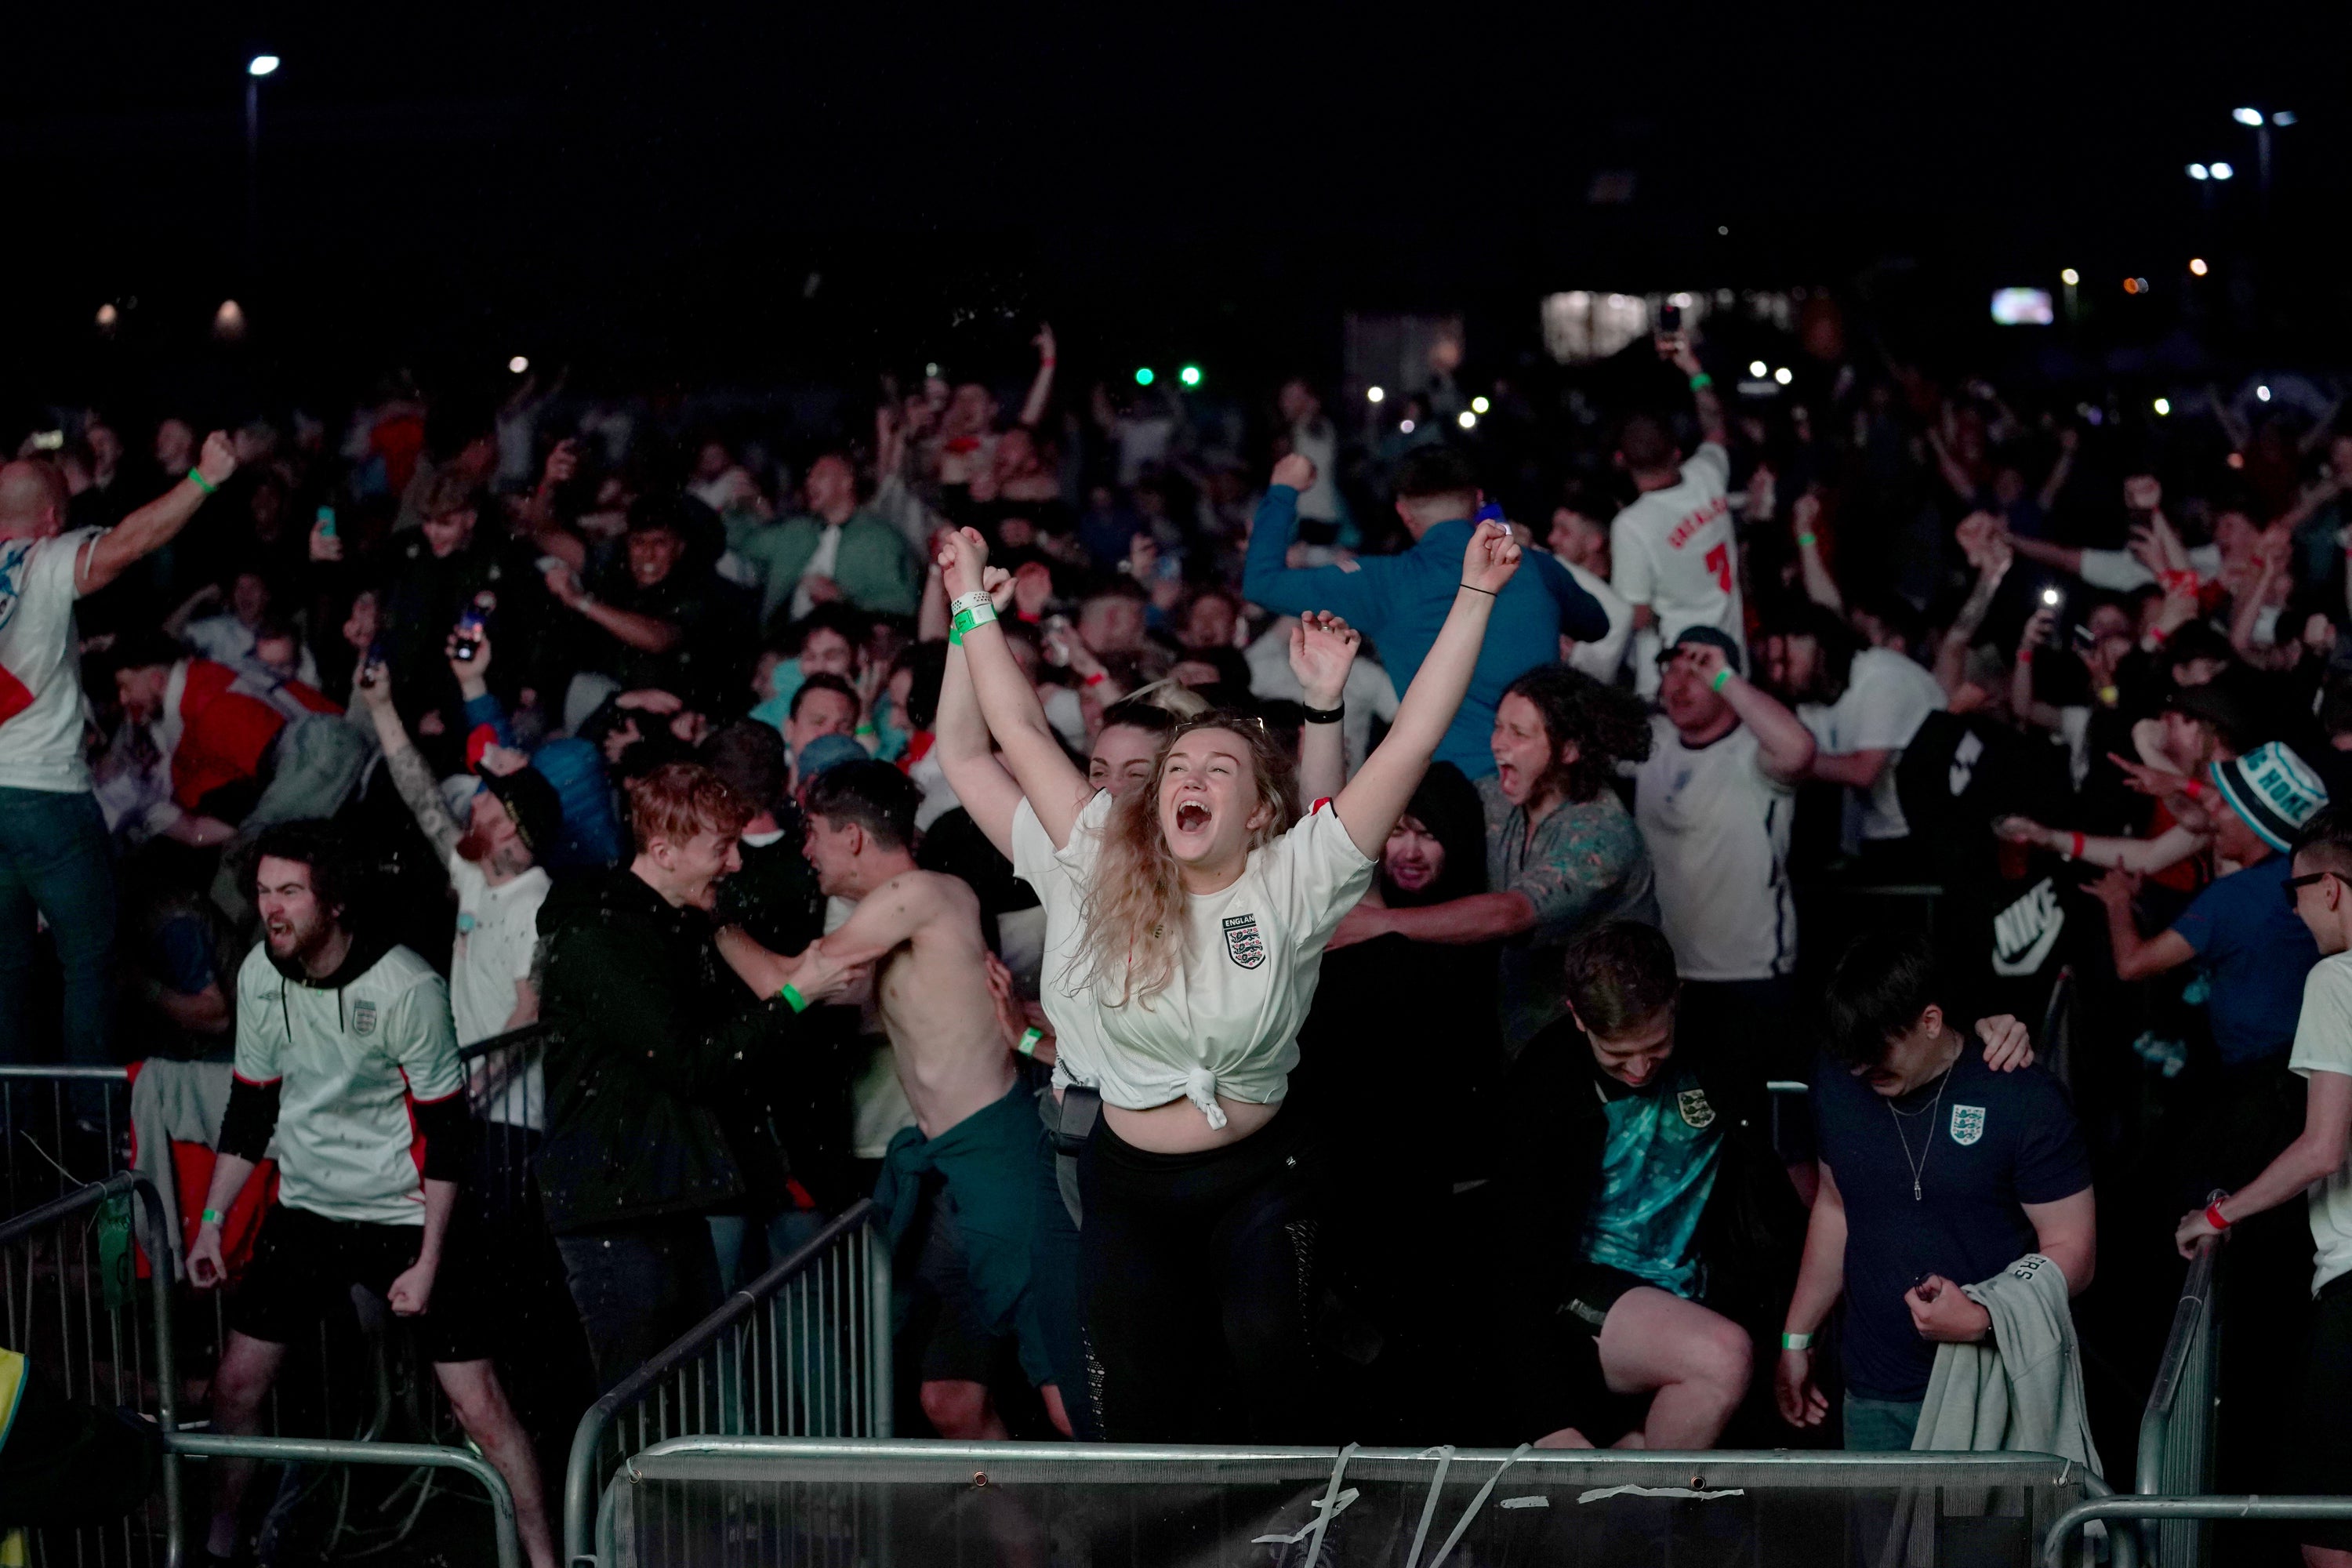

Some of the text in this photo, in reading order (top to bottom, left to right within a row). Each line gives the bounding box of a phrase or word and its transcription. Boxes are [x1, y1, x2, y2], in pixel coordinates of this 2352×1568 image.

[1705, 542, 1732, 594] 7
[2258, 768, 2312, 820] HOME
[1994, 877, 2057, 958] NIKE
